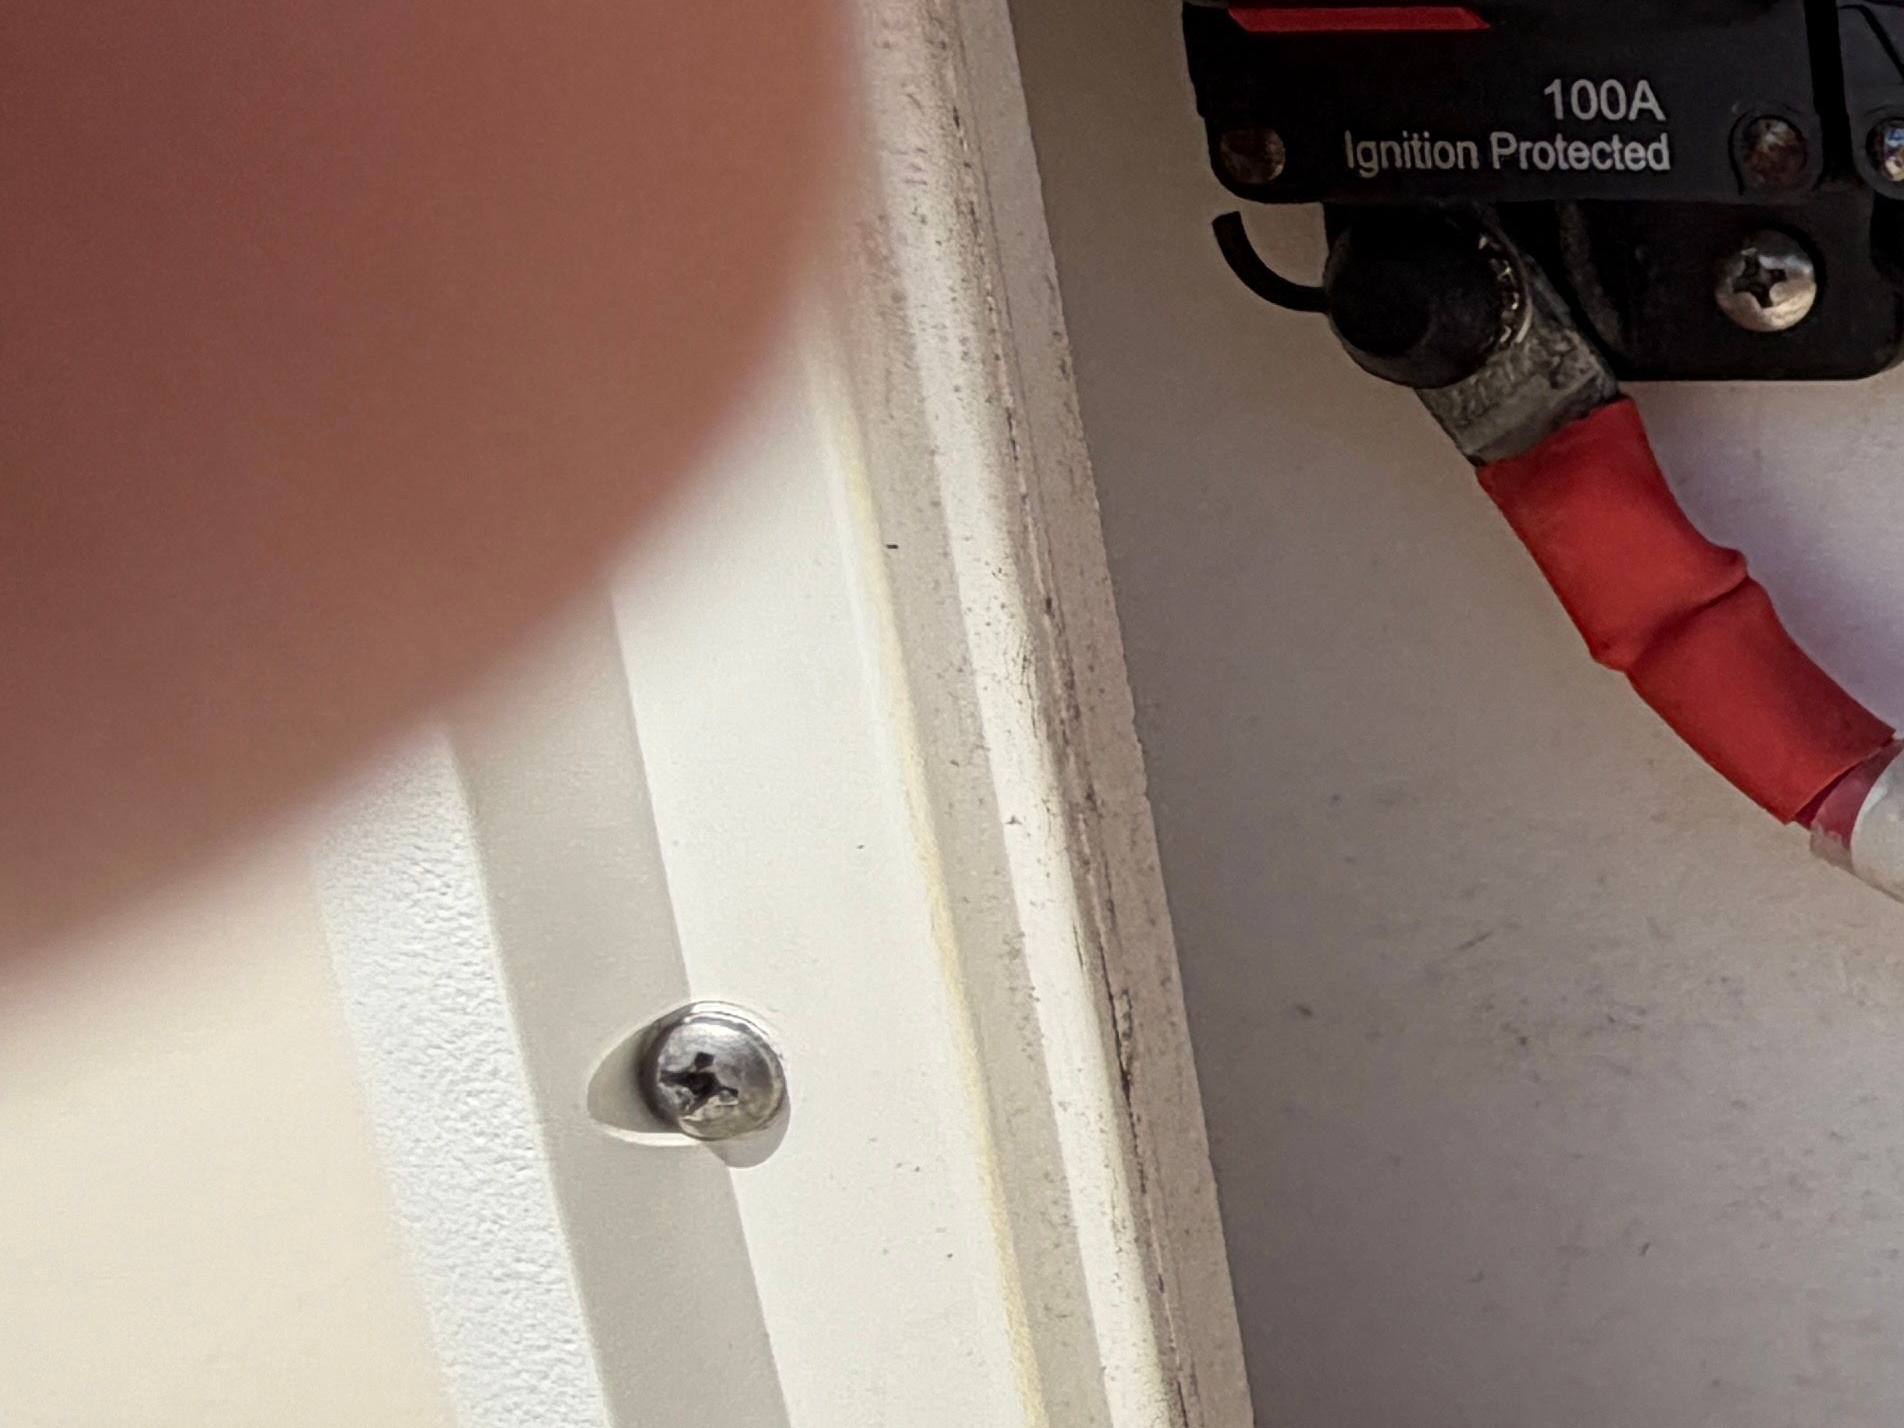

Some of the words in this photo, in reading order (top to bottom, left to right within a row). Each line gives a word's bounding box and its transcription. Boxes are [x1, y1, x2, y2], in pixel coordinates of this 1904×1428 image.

[1543, 78, 1666, 121] 100A
[1344, 130, 1480, 178] Ignition
[1490, 131, 1671, 171] Protected
